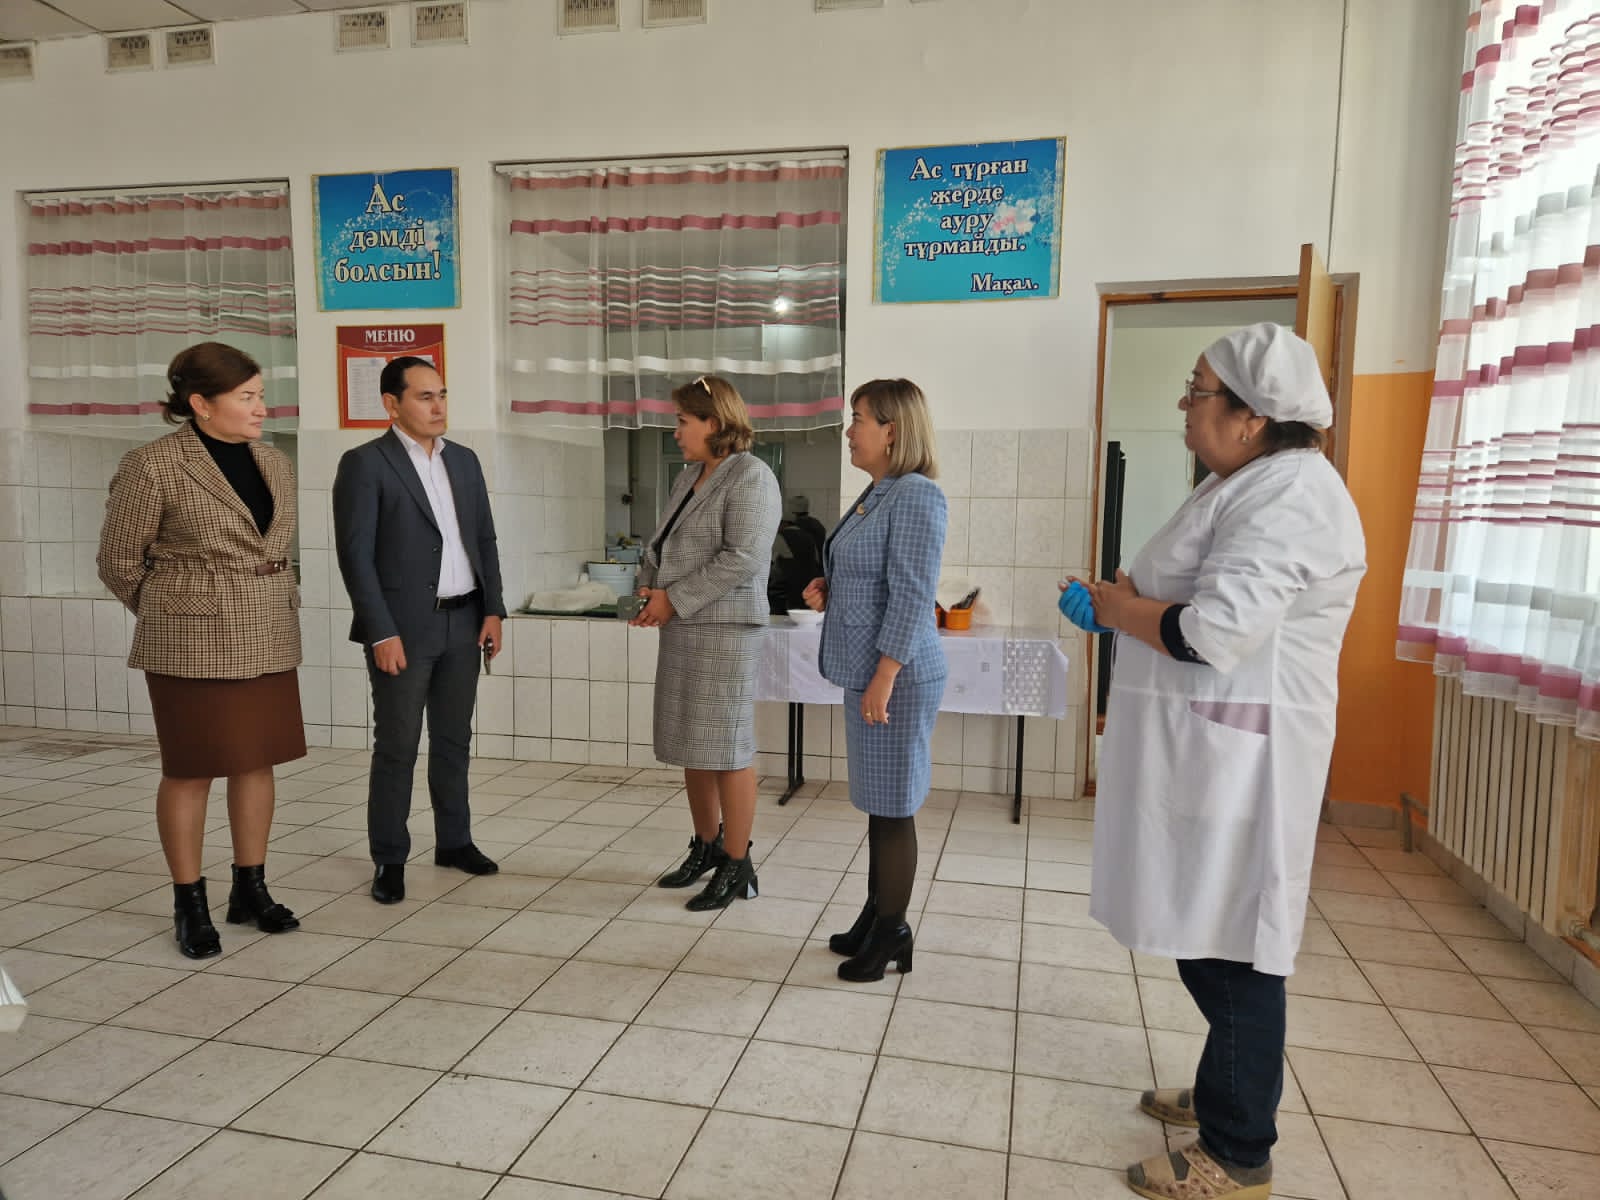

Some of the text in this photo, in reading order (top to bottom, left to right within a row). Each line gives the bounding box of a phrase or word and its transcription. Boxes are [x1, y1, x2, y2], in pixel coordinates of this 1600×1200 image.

[910, 156, 942, 181] Ас
[366, 183, 406, 214] Ас
[931, 186, 1003, 208] жерде
[348, 218, 425, 252] дәмді
[941, 213, 993, 234] ауру
[334, 250, 441, 283] болсын!
[971, 273, 1039, 296] Мақал.
[365, 329, 416, 343] МЕНЮ
